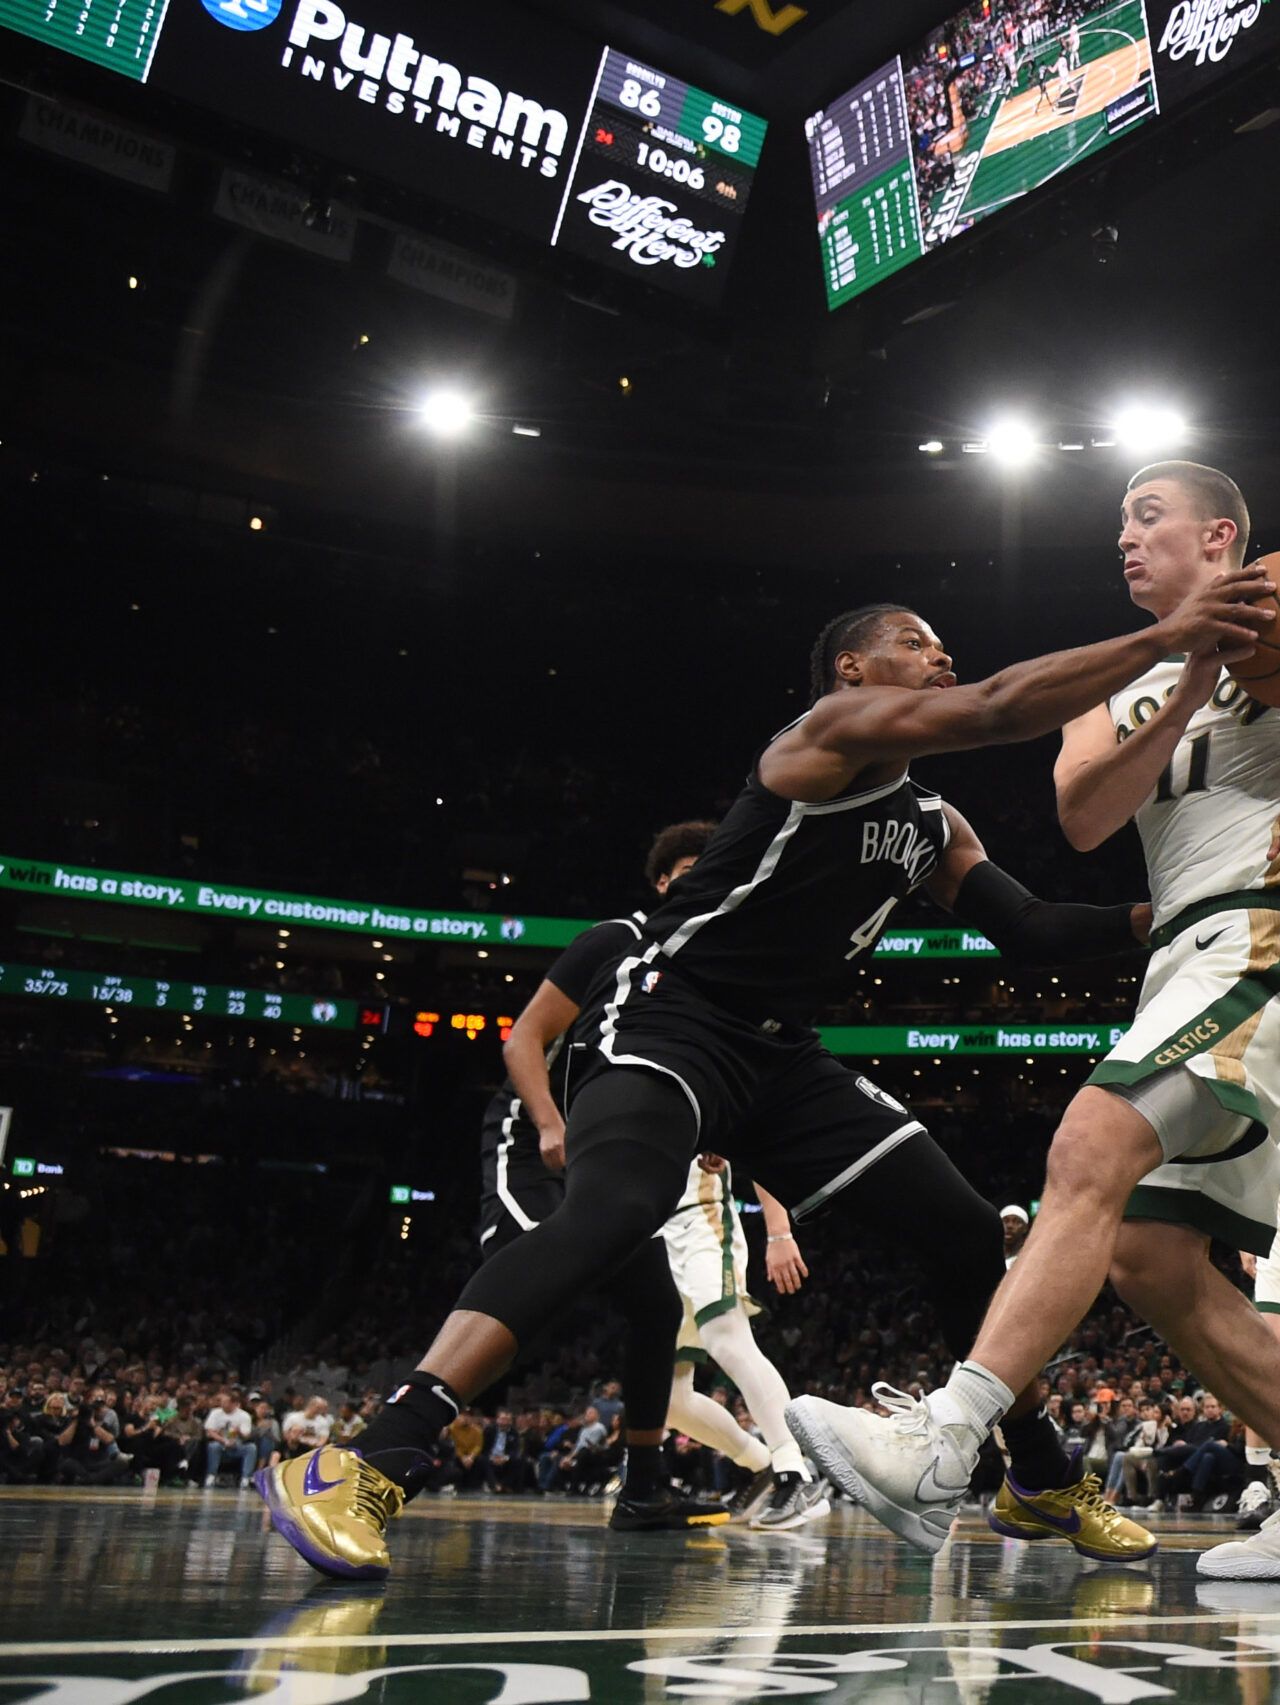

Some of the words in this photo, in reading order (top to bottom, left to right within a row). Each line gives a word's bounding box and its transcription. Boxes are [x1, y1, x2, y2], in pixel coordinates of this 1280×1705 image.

[1195, 4, 1261, 66] Here
[289, 0, 568, 156] Putnam
[619, 79, 661, 117] 86
[281, 47, 558, 178] INVESTMENTS
[702, 116, 741, 153] 98
[36, 103, 166, 169] CHAMPIONS
[595, 128, 614, 145] 24
[637, 142, 705, 190] 10:06
[229, 182, 350, 240] CHAMPS
[716, 181, 738, 200] 4th
[576, 179, 726, 253] Different
[611, 222, 703, 268] Here
[399, 243, 509, 298] CHAMPIONS
[9, 865, 52, 885] win
[54, 868, 98, 892] has
[101, 879, 117, 895] a
[120, 880, 186, 905] story.
[197, 887, 264, 915] Every
[264, 900, 370, 927] customer
[371, 908, 411, 931] has
[413, 917, 429, 932] a
[431, 917, 488, 939] story.
[844, 896, 899, 961] 4
[927, 935, 960, 950] win
[24, 978, 69, 996] 35/75
[92, 985, 134, 1003] 15/38
[263, 1004, 282, 1019] 40
[907, 1030, 960, 1051] Every
[963, 1029, 996, 1047] win
[997, 1029, 1031, 1048] has
[1034, 1033, 1047, 1047] a
[1049, 1030, 1101, 1051] story.
[1154, 1018, 1220, 1065] CELTICS
